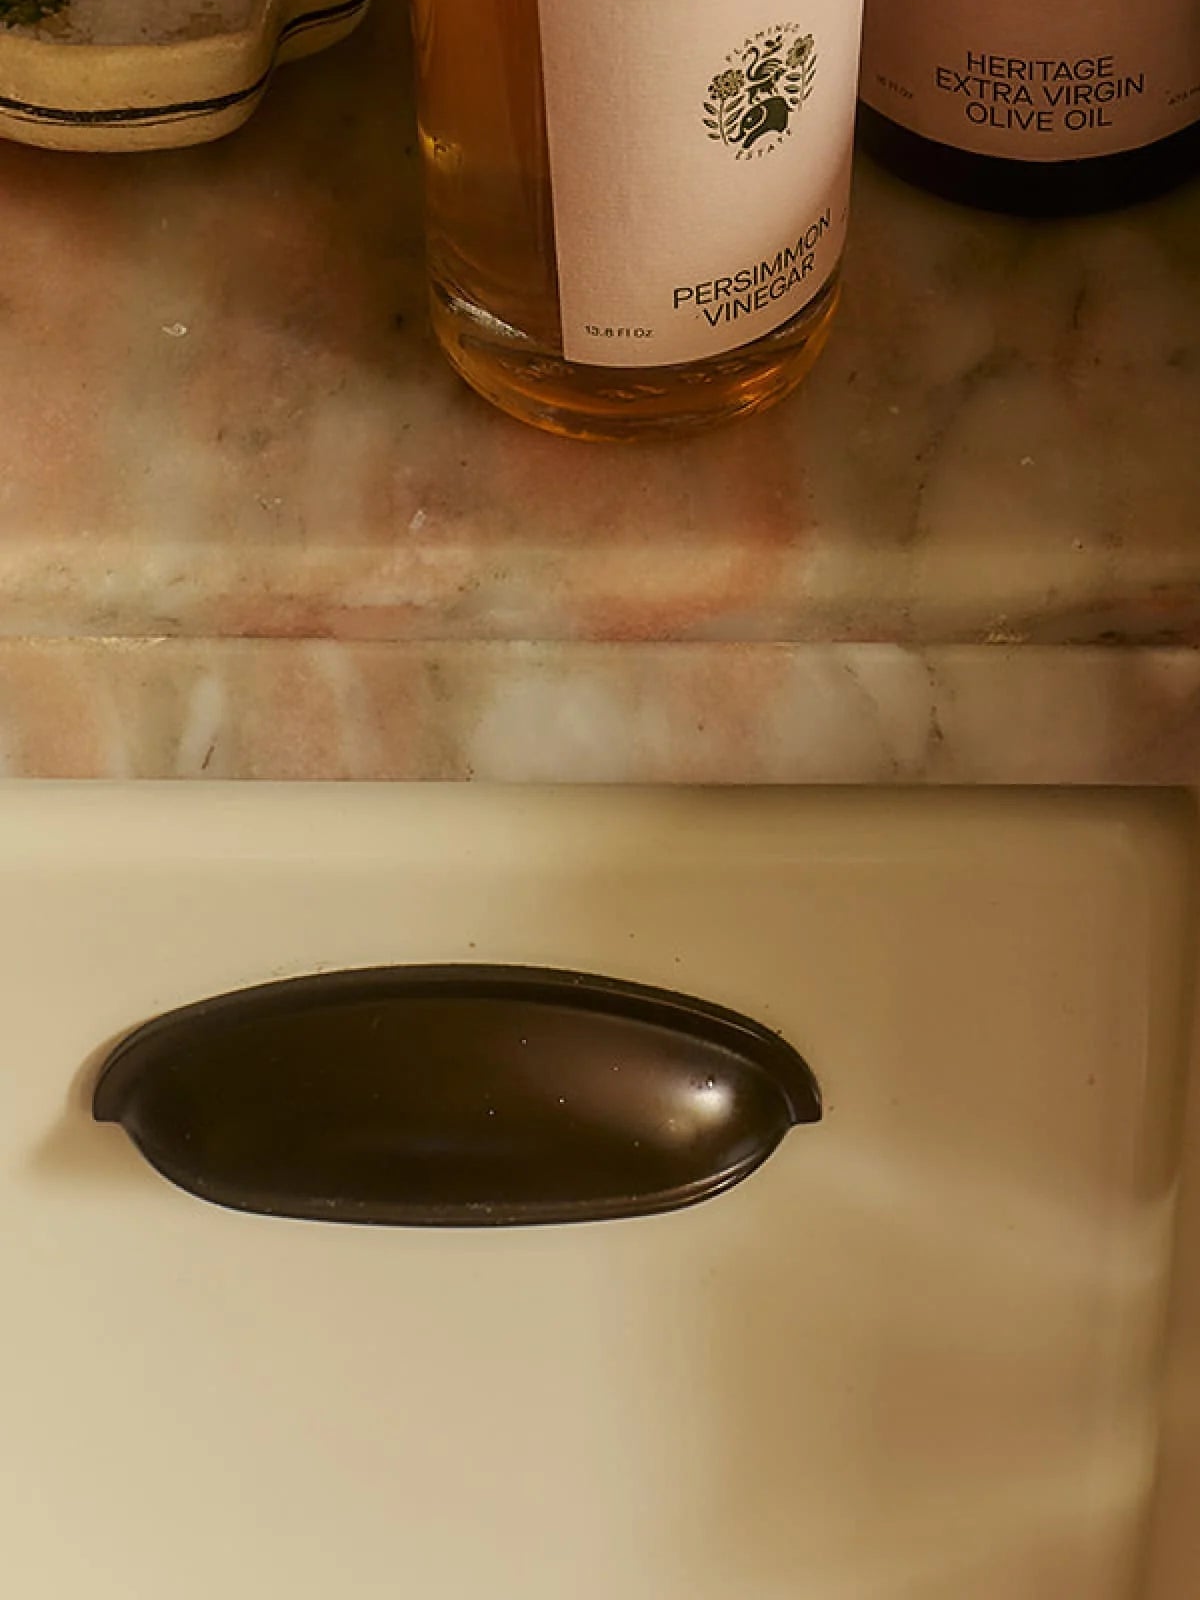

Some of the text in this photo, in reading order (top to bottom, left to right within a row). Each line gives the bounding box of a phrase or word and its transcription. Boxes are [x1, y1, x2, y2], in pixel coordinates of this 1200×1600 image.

[966, 51, 1114, 82] HERITAGE
[935, 67, 1032, 106] EXTRA
[1042, 73, 1145, 107] VIRGIN
[965, 102, 1112, 131] OLIVE OIL
[673, 207, 831, 310] PERSIMMON
[702, 252, 816, 327] VINEGAR
